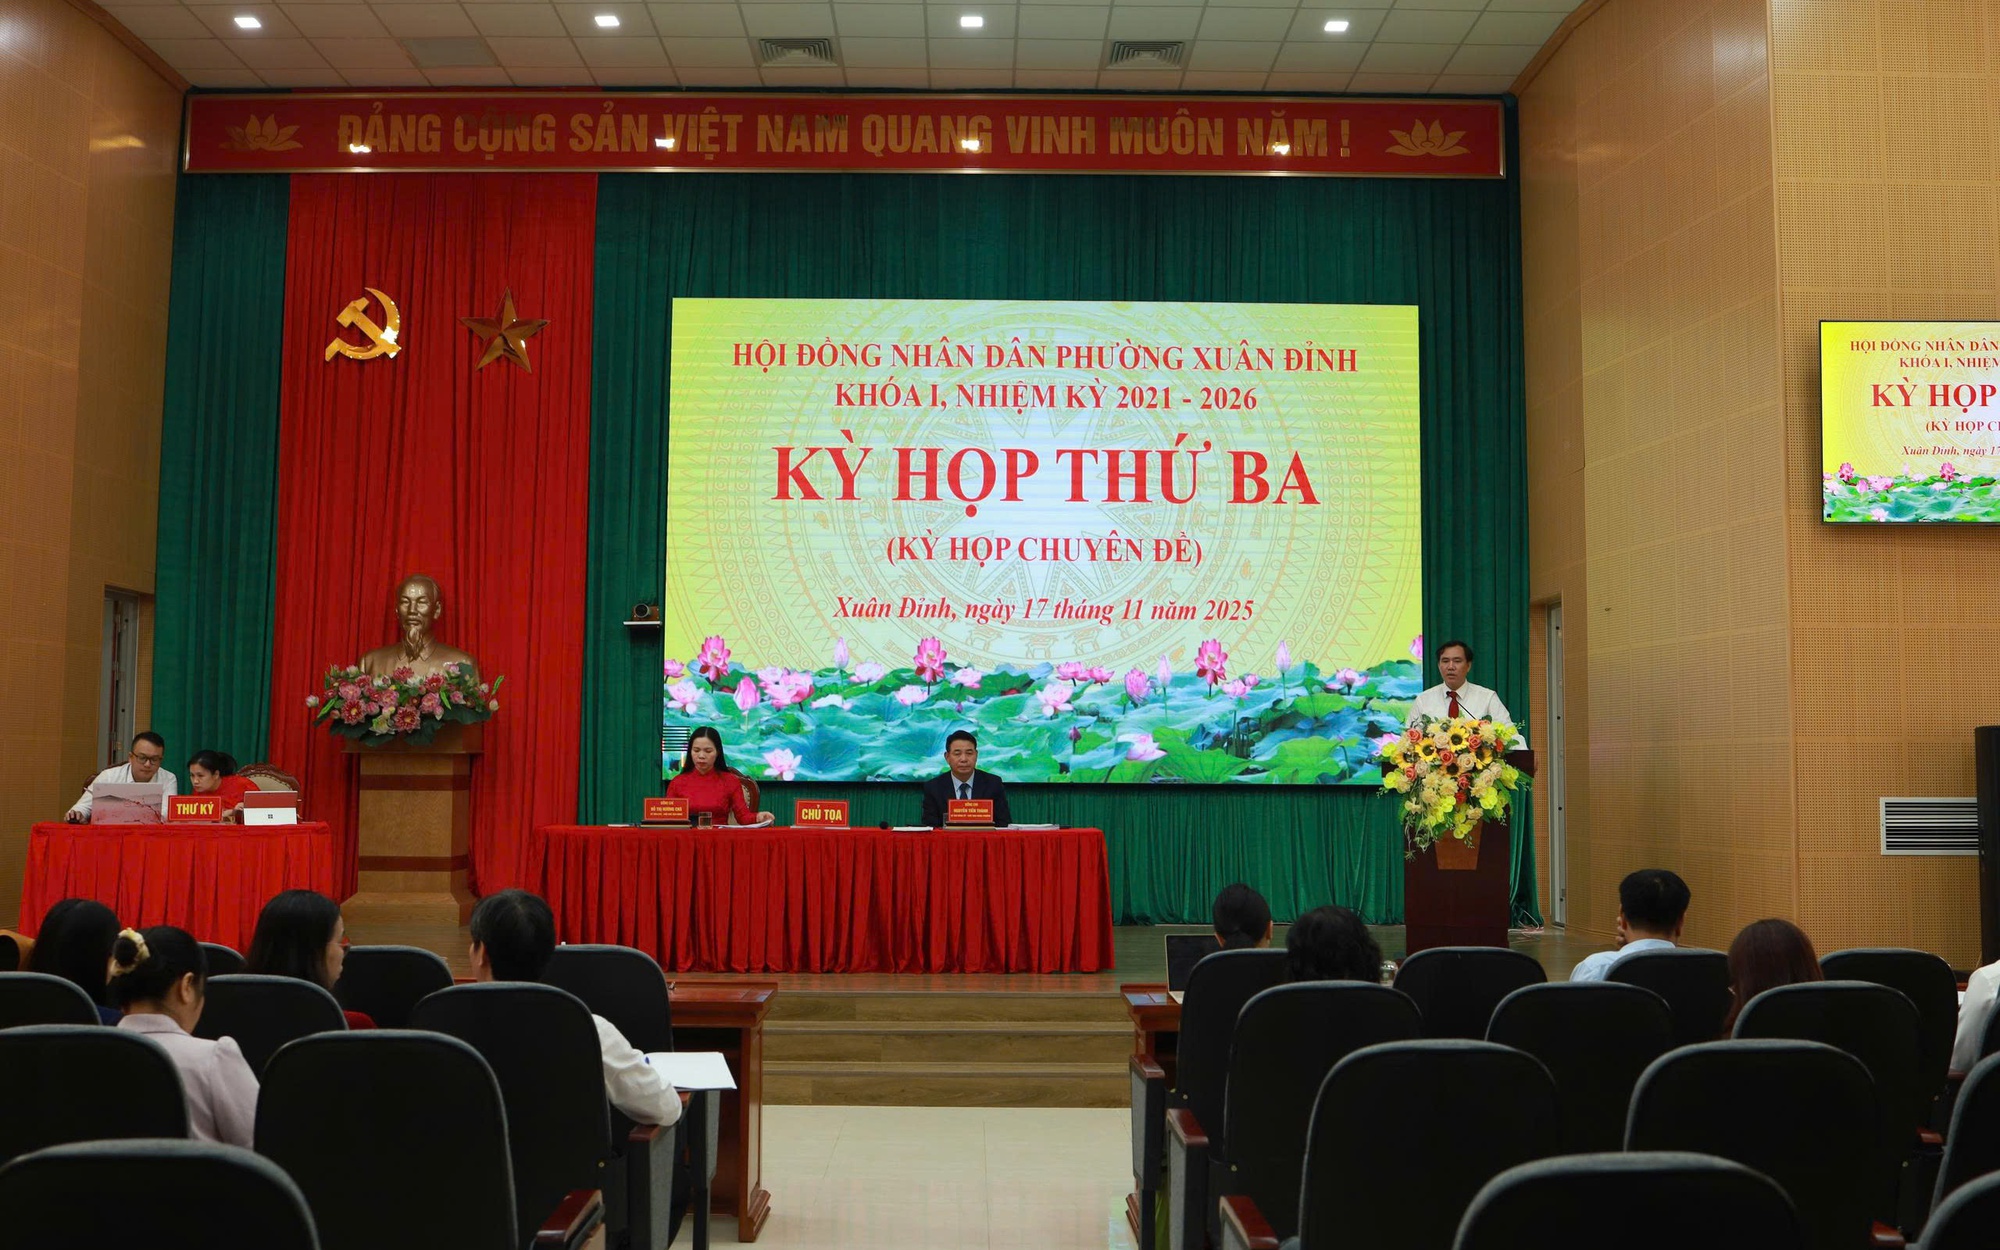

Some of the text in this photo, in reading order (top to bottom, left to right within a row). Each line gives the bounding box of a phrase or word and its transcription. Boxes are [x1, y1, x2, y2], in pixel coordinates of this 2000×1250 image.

[337, 101, 442, 152] ĐẢNG
[454, 105, 556, 160] CỘNG
[569, 101, 648, 152] SẢN
[663, 106, 743, 160] VIỆT
[757, 114, 848, 152] NAM
[862, 114, 992, 157] QUANG
[1005, 115, 1095, 154] VINH
[1109, 108, 1223, 155] MUÔN
[1237, 109, 1328, 157] NĂM
[731, 336, 1358, 373] HỘI ĐỒNG NHÂN DÂN PHƯỜNG XUÂN ĐỈNH
[1900, 354, 1941, 368] KHÓA
[1925, 337, 1966, 352] NHÂN
[834, 376, 923, 407] KHÓA
[930, 383, 948, 411] I,
[955, 381, 1055, 415] NHIỆM
[1065, 378, 1107, 408] KỲ
[1117, 385, 1172, 410] 2021
[1200, 386, 1257, 410] 2026
[1871, 376, 1997, 413] KỲ HỌP
[1925, 417, 1950, 433] (KỲ
[1955, 420, 1985, 434] HỌP
[771, 429, 1321, 518] KỲ HỌP THỨ BA
[886, 529, 1204, 569] (KỲ HỌP CHUYÊN ĐỀ)
[832, 596, 1254, 626] Xuân Đỉnh, ngày 17 tháng 11 năm 2025
[176, 801, 214, 815] THƯ KÝ
[802, 804, 843, 823] CHỦ TỌA
